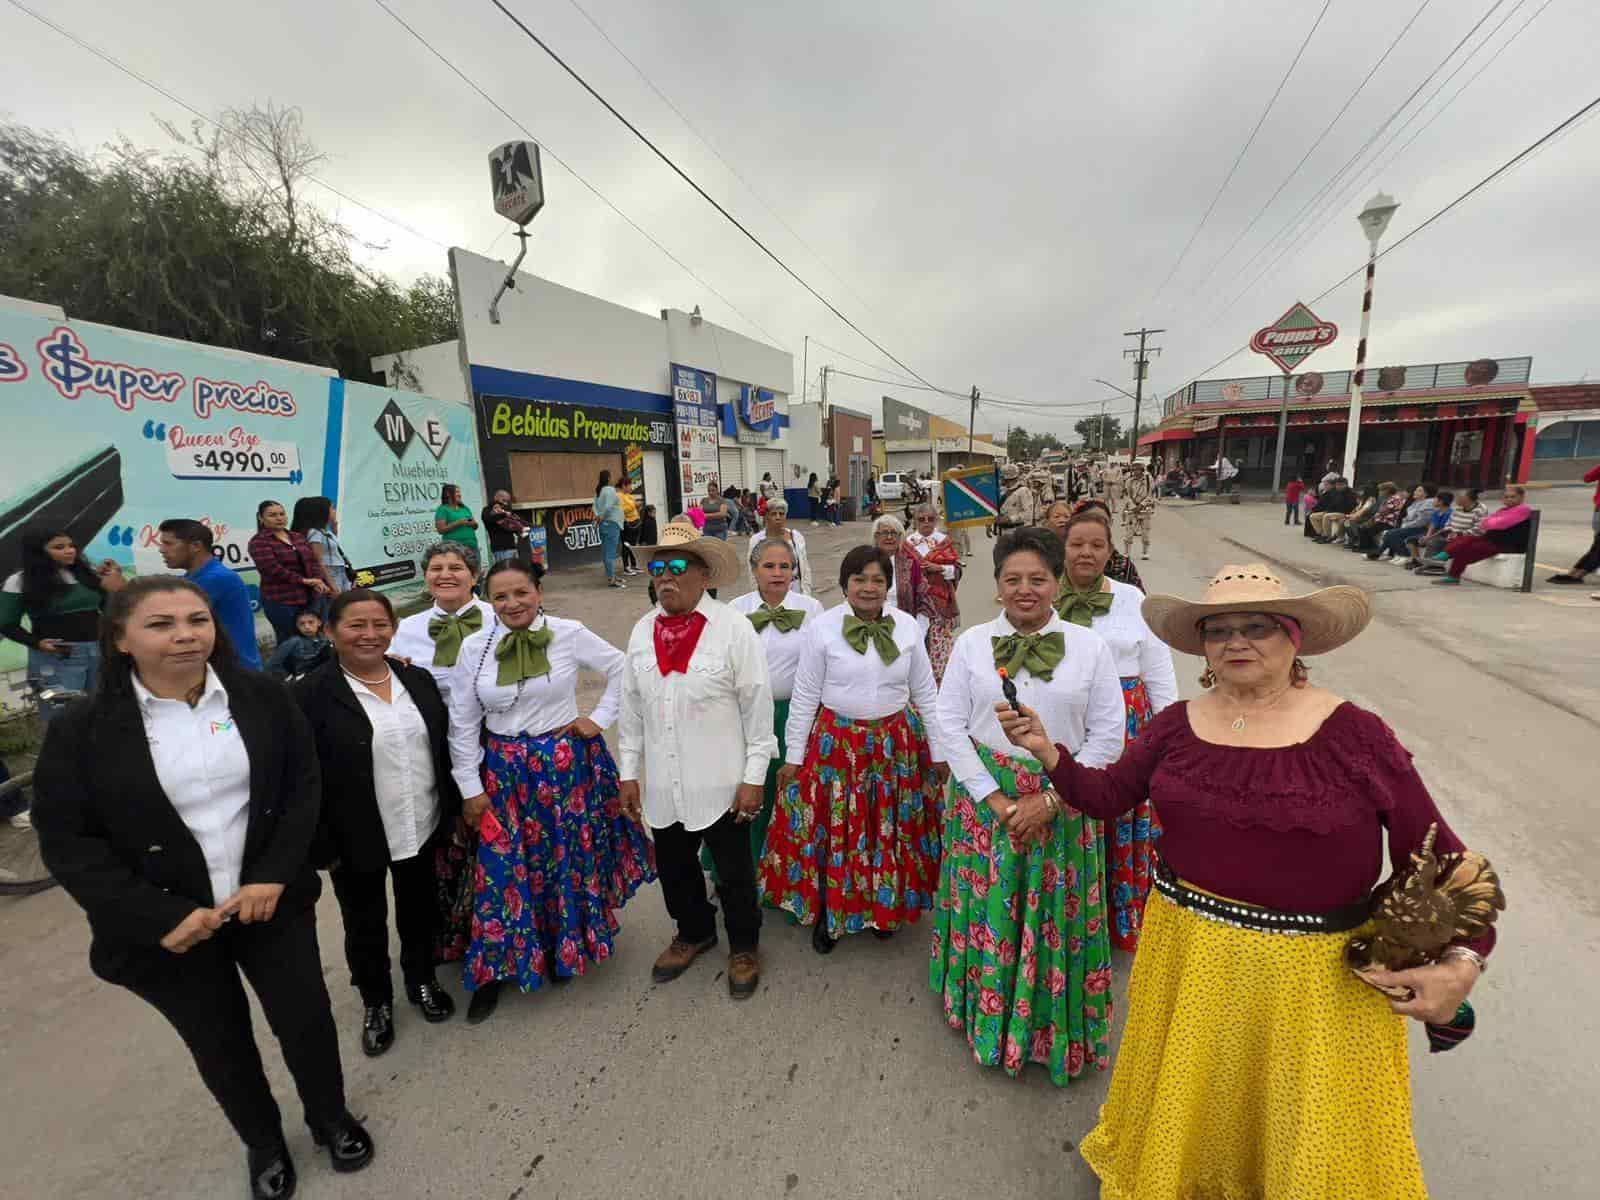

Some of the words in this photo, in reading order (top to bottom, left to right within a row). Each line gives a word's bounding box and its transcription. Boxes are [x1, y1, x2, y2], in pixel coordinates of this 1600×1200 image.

[196, 380, 295, 414] precios
[169, 426, 225, 450] Queen
[228, 427, 261, 451] Size
[384, 413, 406, 442] M
[427, 420, 442, 447] E
[491, 402, 570, 440] Bebidas
[573, 410, 650, 447] Preparadas
[383, 482, 446, 502] ESPINO
[564, 523, 603, 551] JFM
